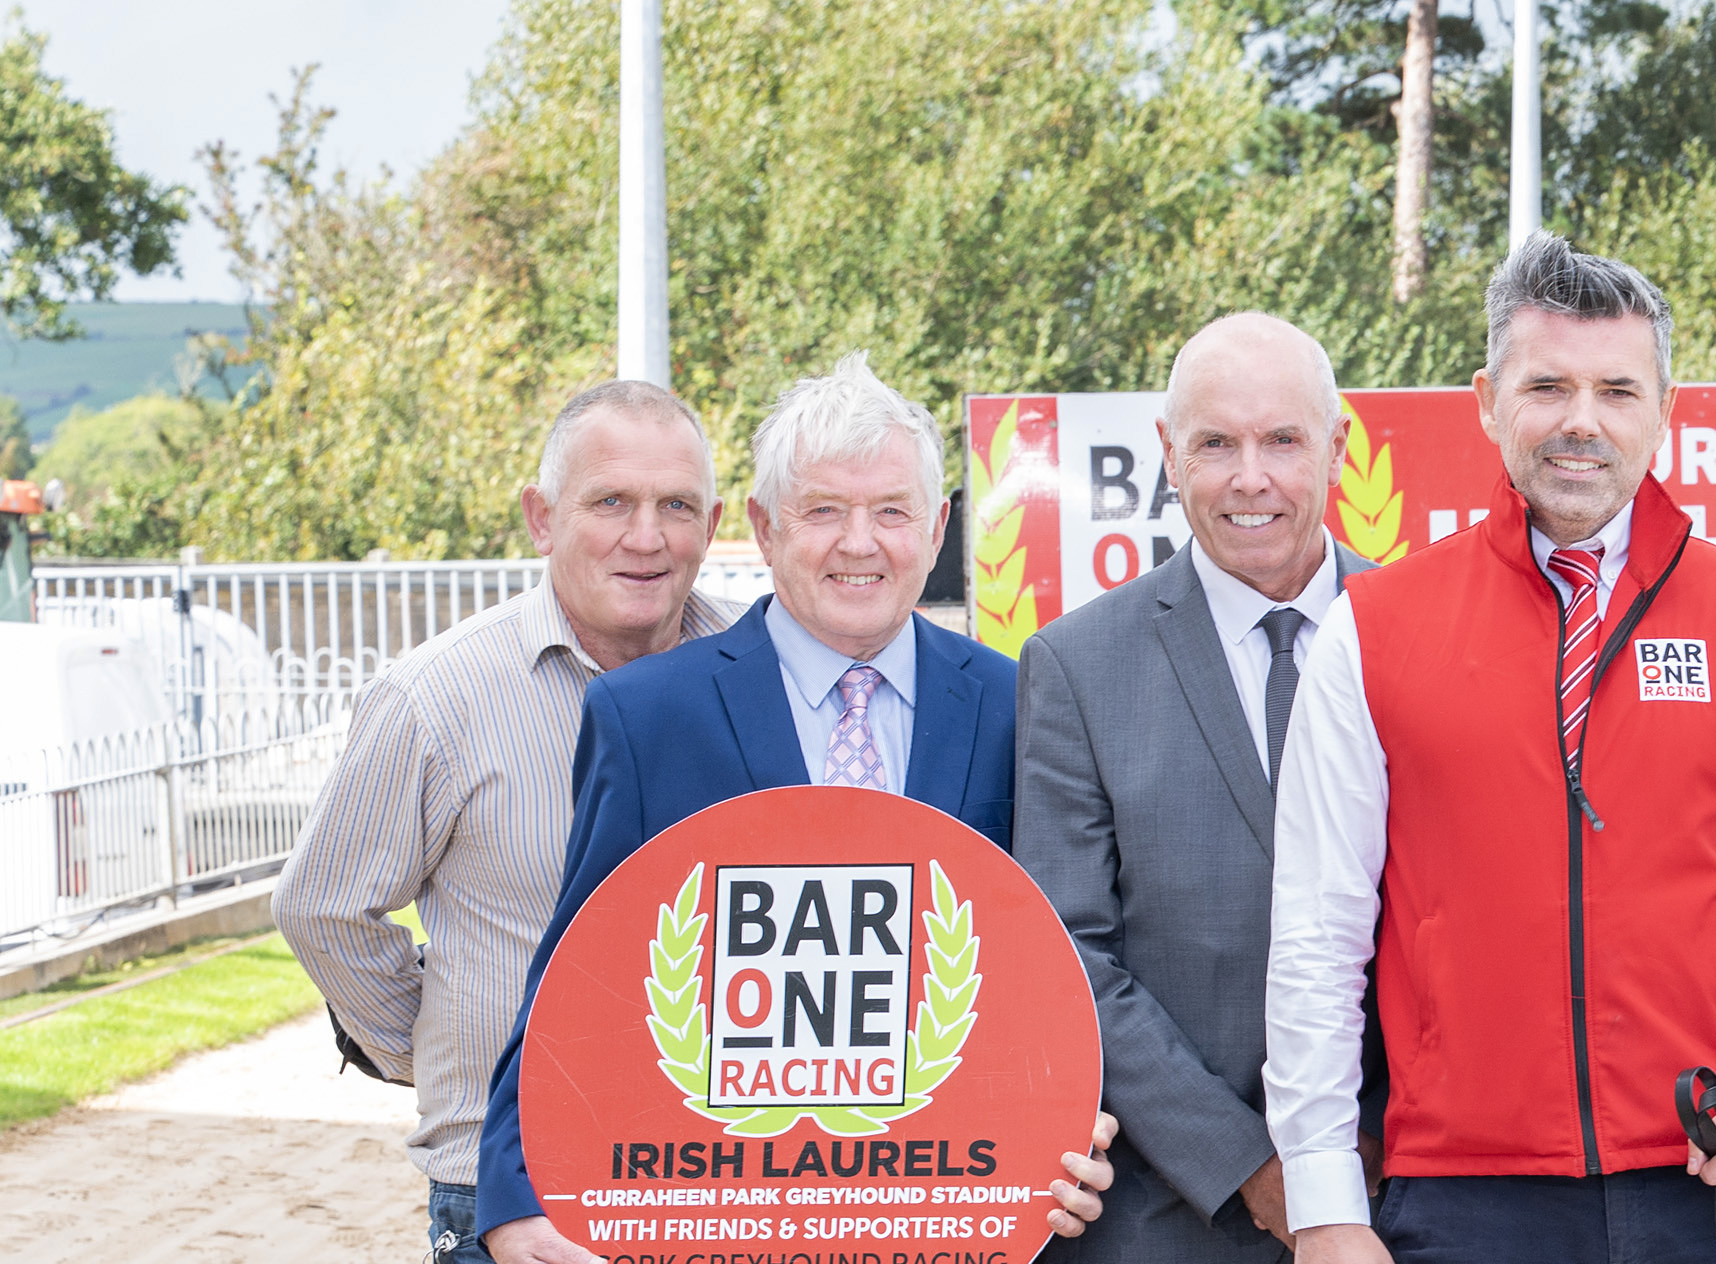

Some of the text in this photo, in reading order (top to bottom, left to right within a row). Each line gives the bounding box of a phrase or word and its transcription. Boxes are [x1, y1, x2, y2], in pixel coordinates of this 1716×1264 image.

[1090, 445, 1181, 521] BA
[1640, 643, 1703, 663] BAR
[1642, 665, 1704, 685] ONE
[1644, 686, 1706, 698] RACING
[727, 879, 903, 957] BAR
[723, 968, 895, 1049] ONE
[719, 1058, 896, 1098] RACING
[612, 1140, 997, 1179] IRISH LAURELS
[581, 1186, 1030, 1207] CURRAHEEN PARK GREYHOUND STADIUM
[588, 1216, 1017, 1241] WITH FRIENDS & SUPPORTERS OF
